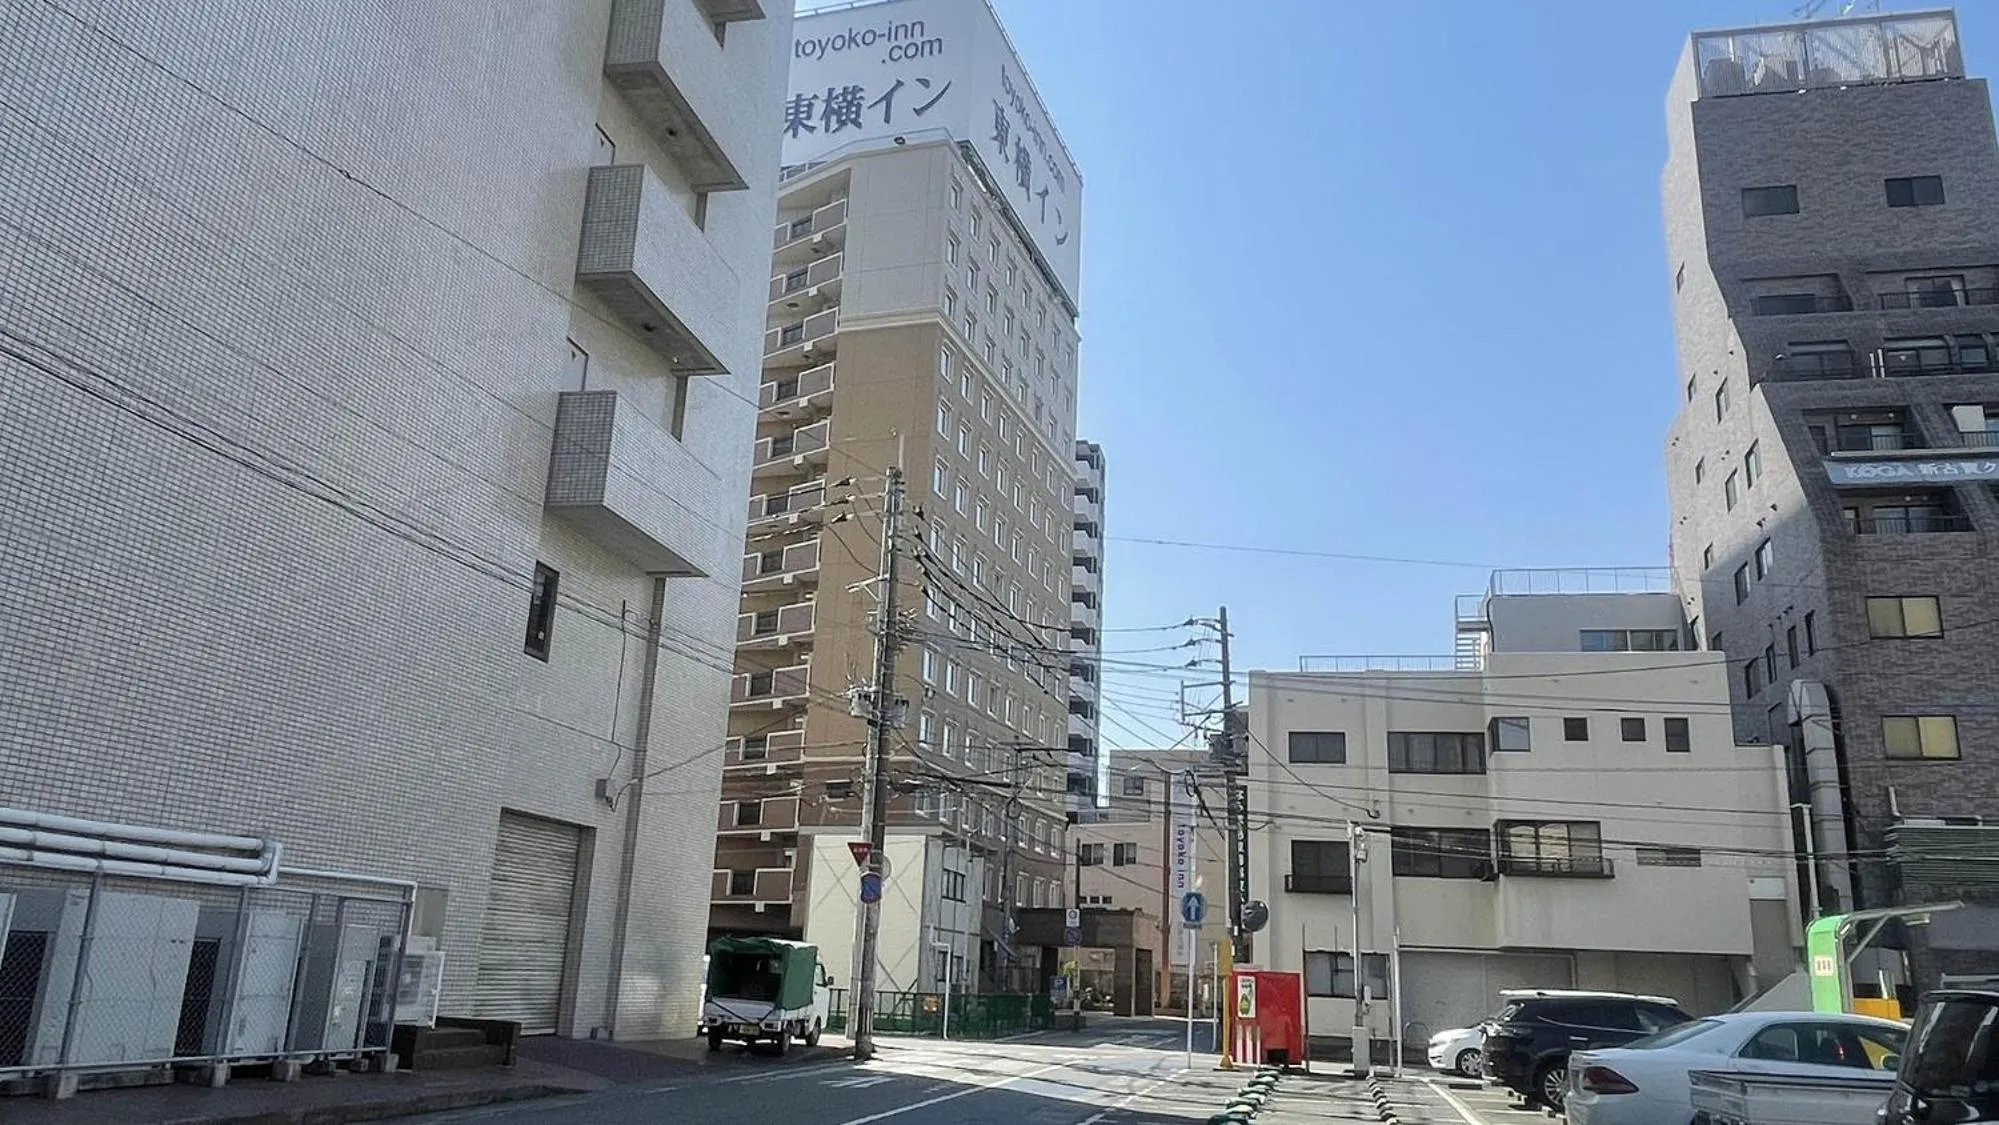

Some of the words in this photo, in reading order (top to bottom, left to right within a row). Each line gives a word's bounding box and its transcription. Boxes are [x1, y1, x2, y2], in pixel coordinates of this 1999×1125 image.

[794, 20, 925, 61] toyoko-inn
[881, 37, 943, 64] .com
[782, 77, 952, 139] 東横イン
